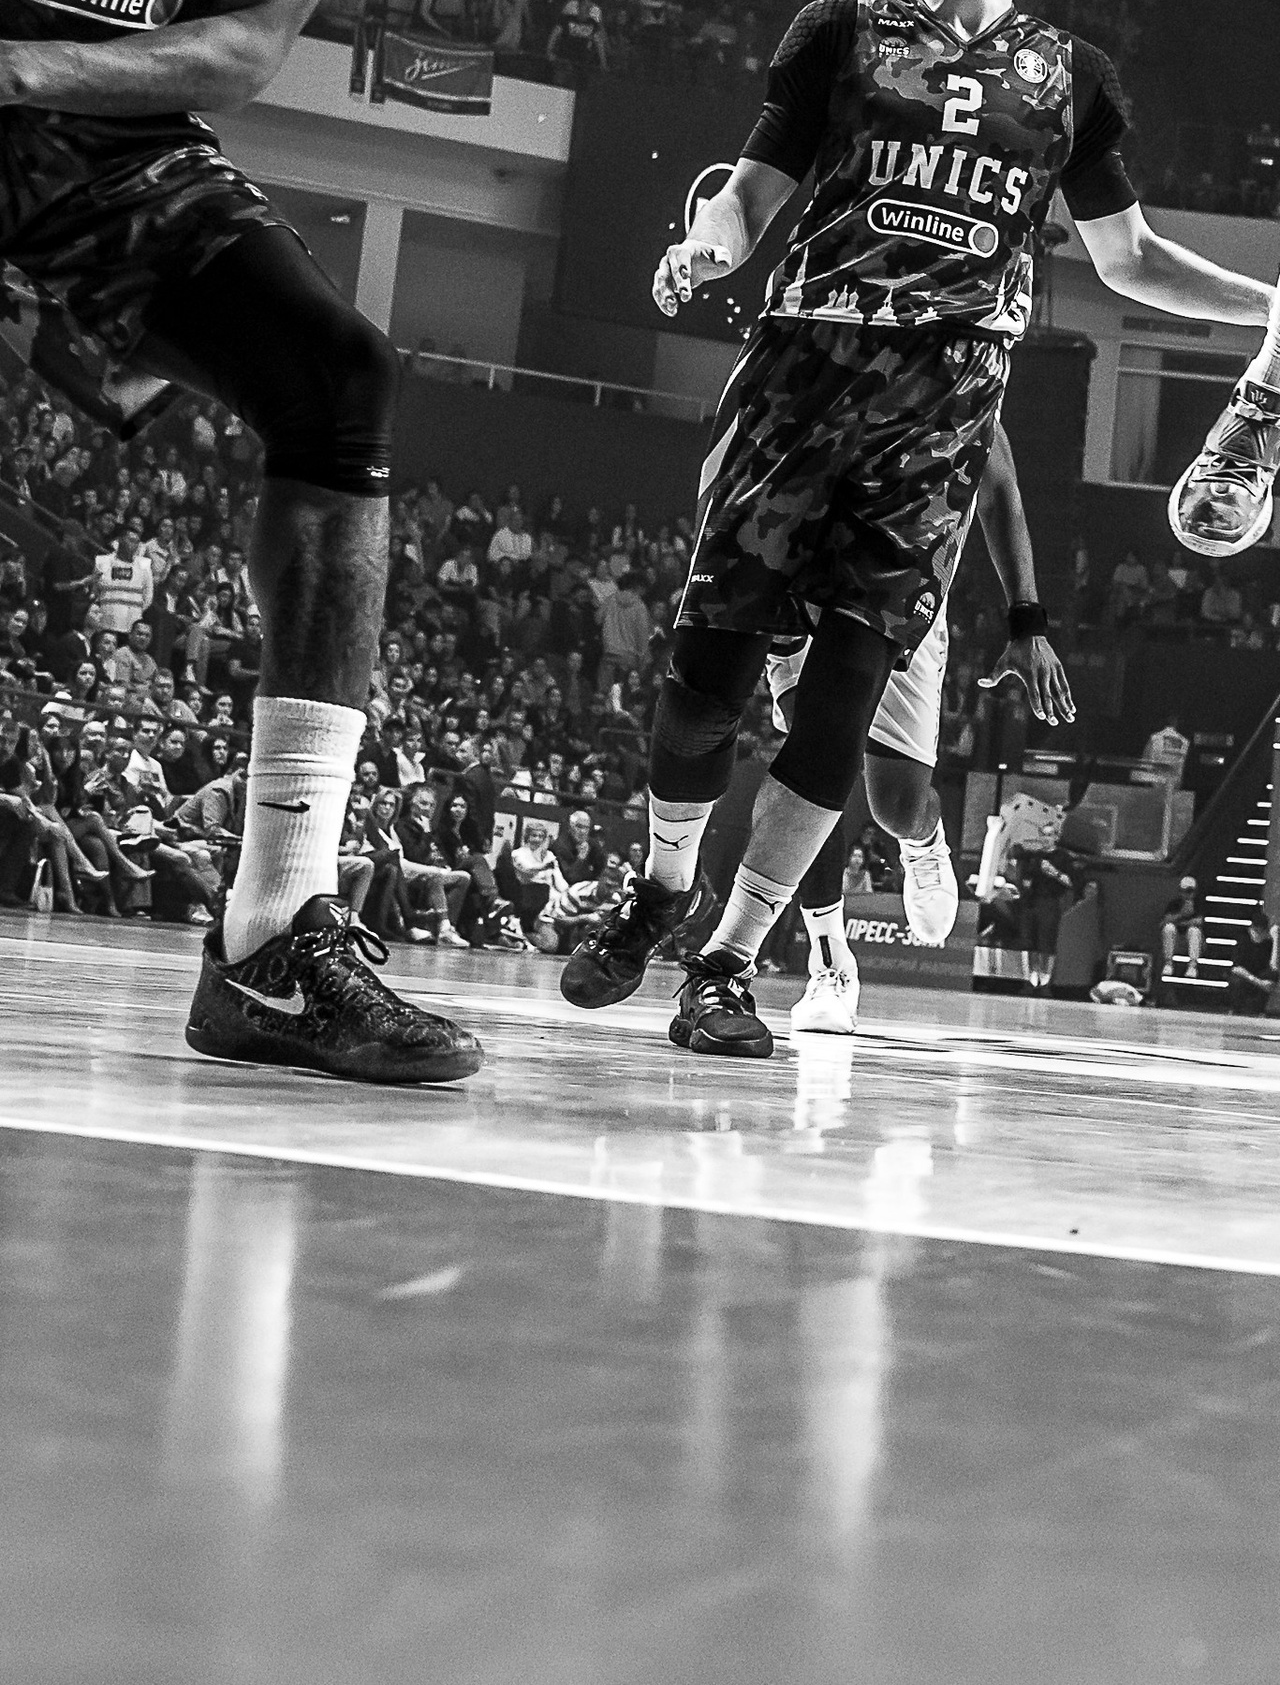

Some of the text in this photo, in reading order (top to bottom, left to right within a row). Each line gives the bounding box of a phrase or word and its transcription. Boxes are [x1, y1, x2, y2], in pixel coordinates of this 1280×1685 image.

[877, 17, 915, 28] MAXX
[941, 73, 984, 136] 2
[868, 140, 1029, 215] UNICS
[881, 206, 965, 242] Winline
[846, 917, 946, 949] ПРЕСС-З
